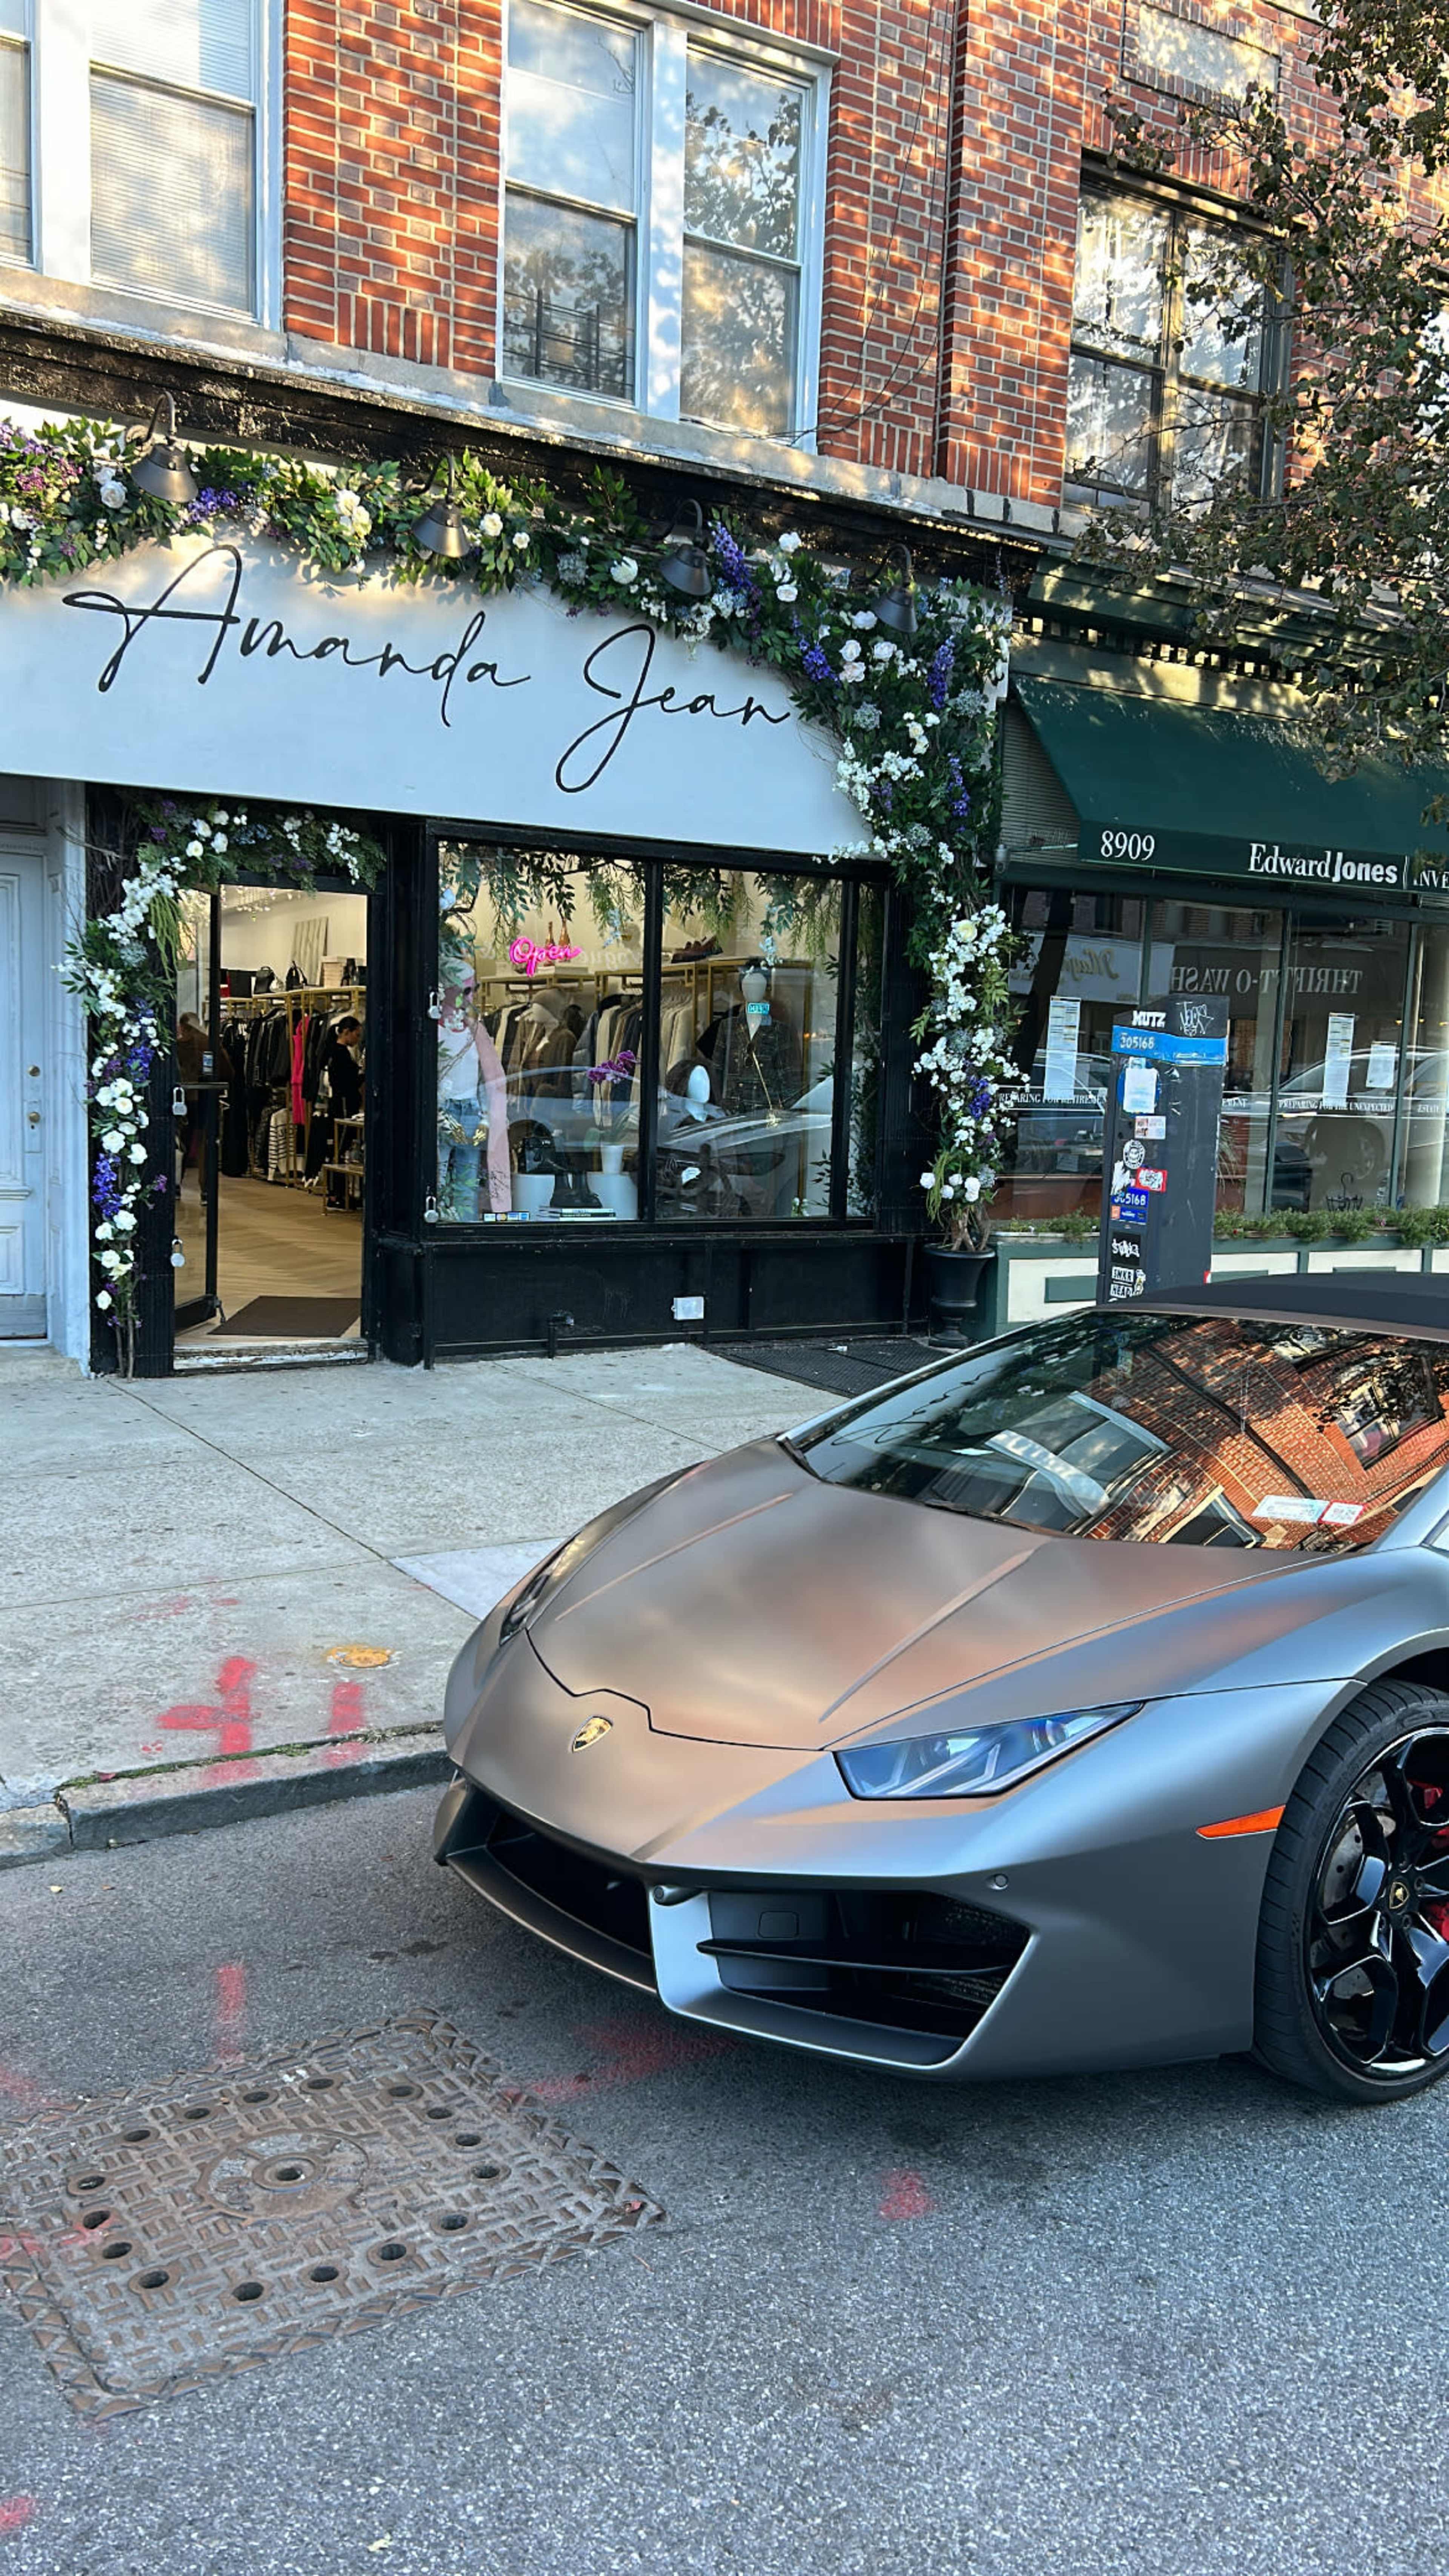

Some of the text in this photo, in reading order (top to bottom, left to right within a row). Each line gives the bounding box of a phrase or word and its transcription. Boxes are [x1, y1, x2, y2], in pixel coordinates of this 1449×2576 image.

[62, 544, 790, 793] Amanda Jean
[1100, 830, 1155, 861] 8909
[1248, 843, 1332, 878] Edward
[1332, 852, 1398, 884] Jones
[509, 937, 583, 978] Open
[1132, 1010, 1166, 1028] MUTZ
[1120, 1033, 1155, 1049] 305168
[1277, 1099, 1318, 1109] PREPARING
[1349, 1102, 1393, 1111] UNEXPECTED
